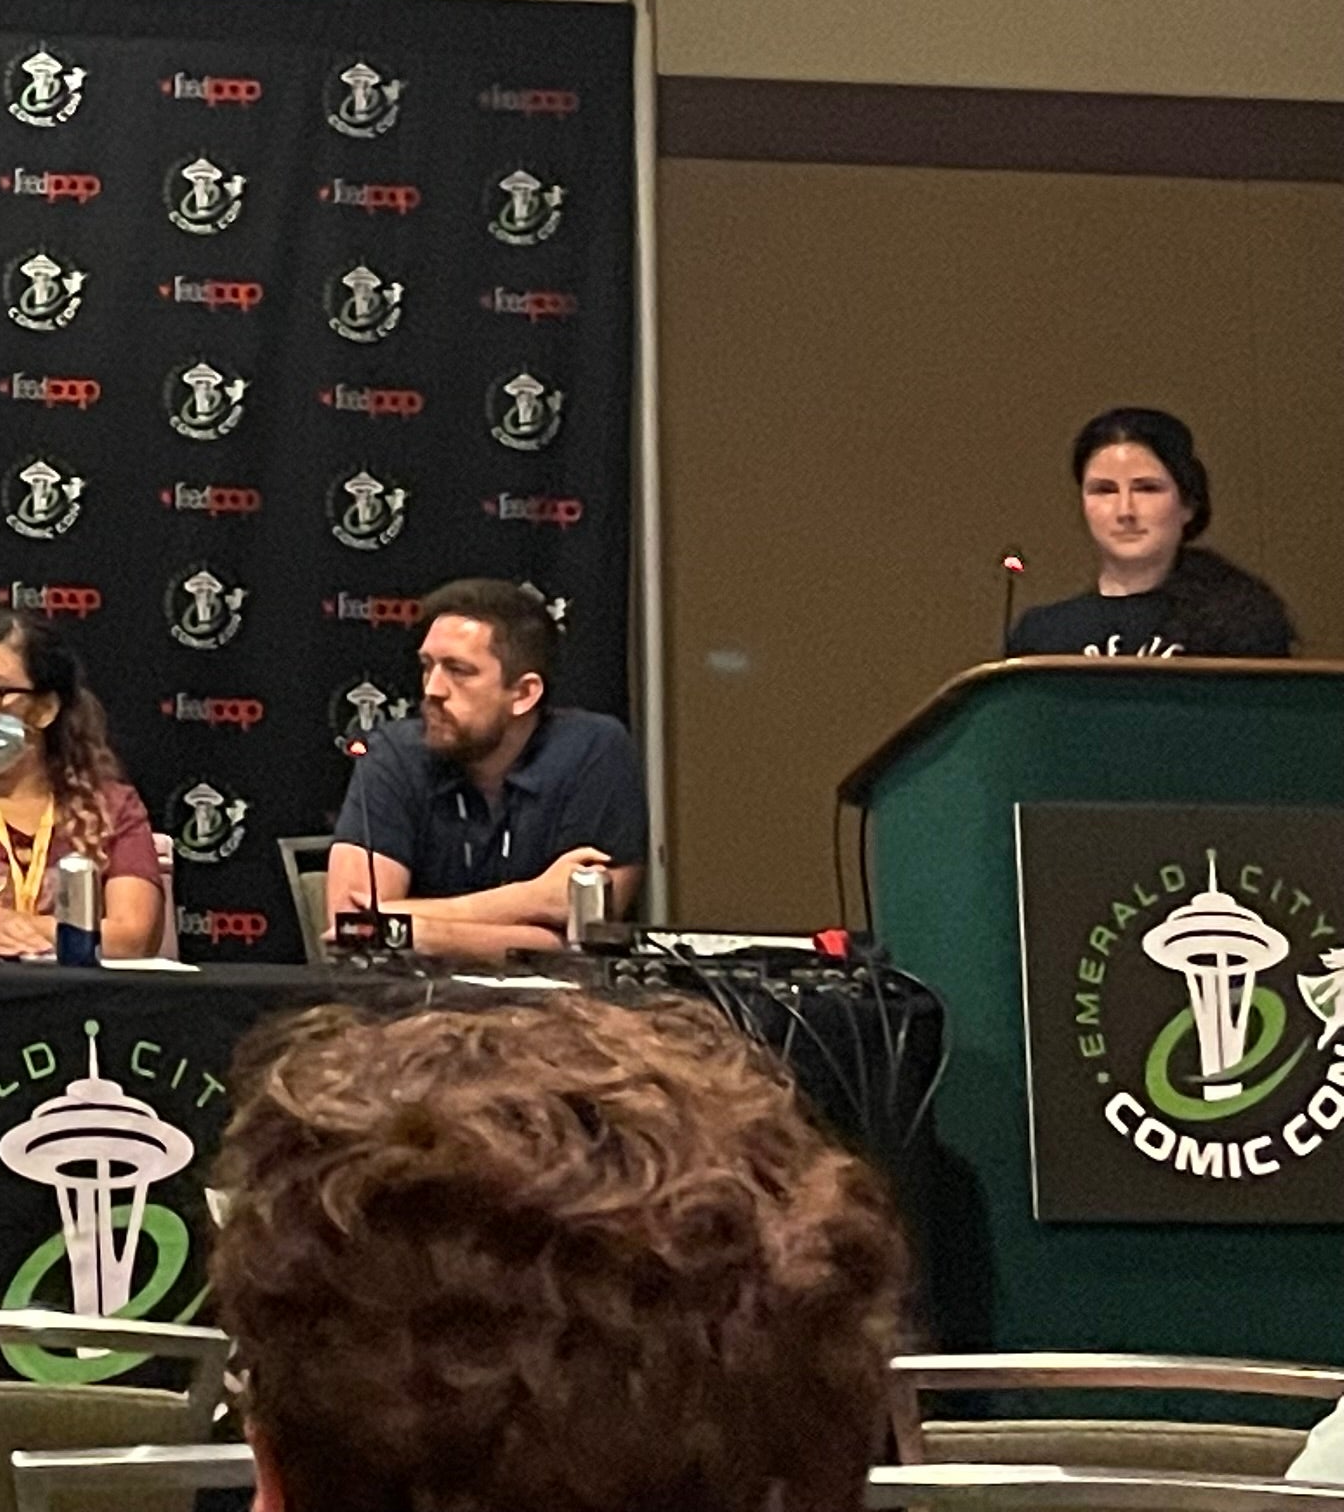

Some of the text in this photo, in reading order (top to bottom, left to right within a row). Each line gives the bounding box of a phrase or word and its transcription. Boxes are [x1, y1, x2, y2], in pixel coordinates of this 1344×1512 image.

[1076, 864, 1335, 1058] EMERALD CITY
[131, 1040, 226, 1108] CIT
[1105, 1092, 1281, 1178] COMIC
